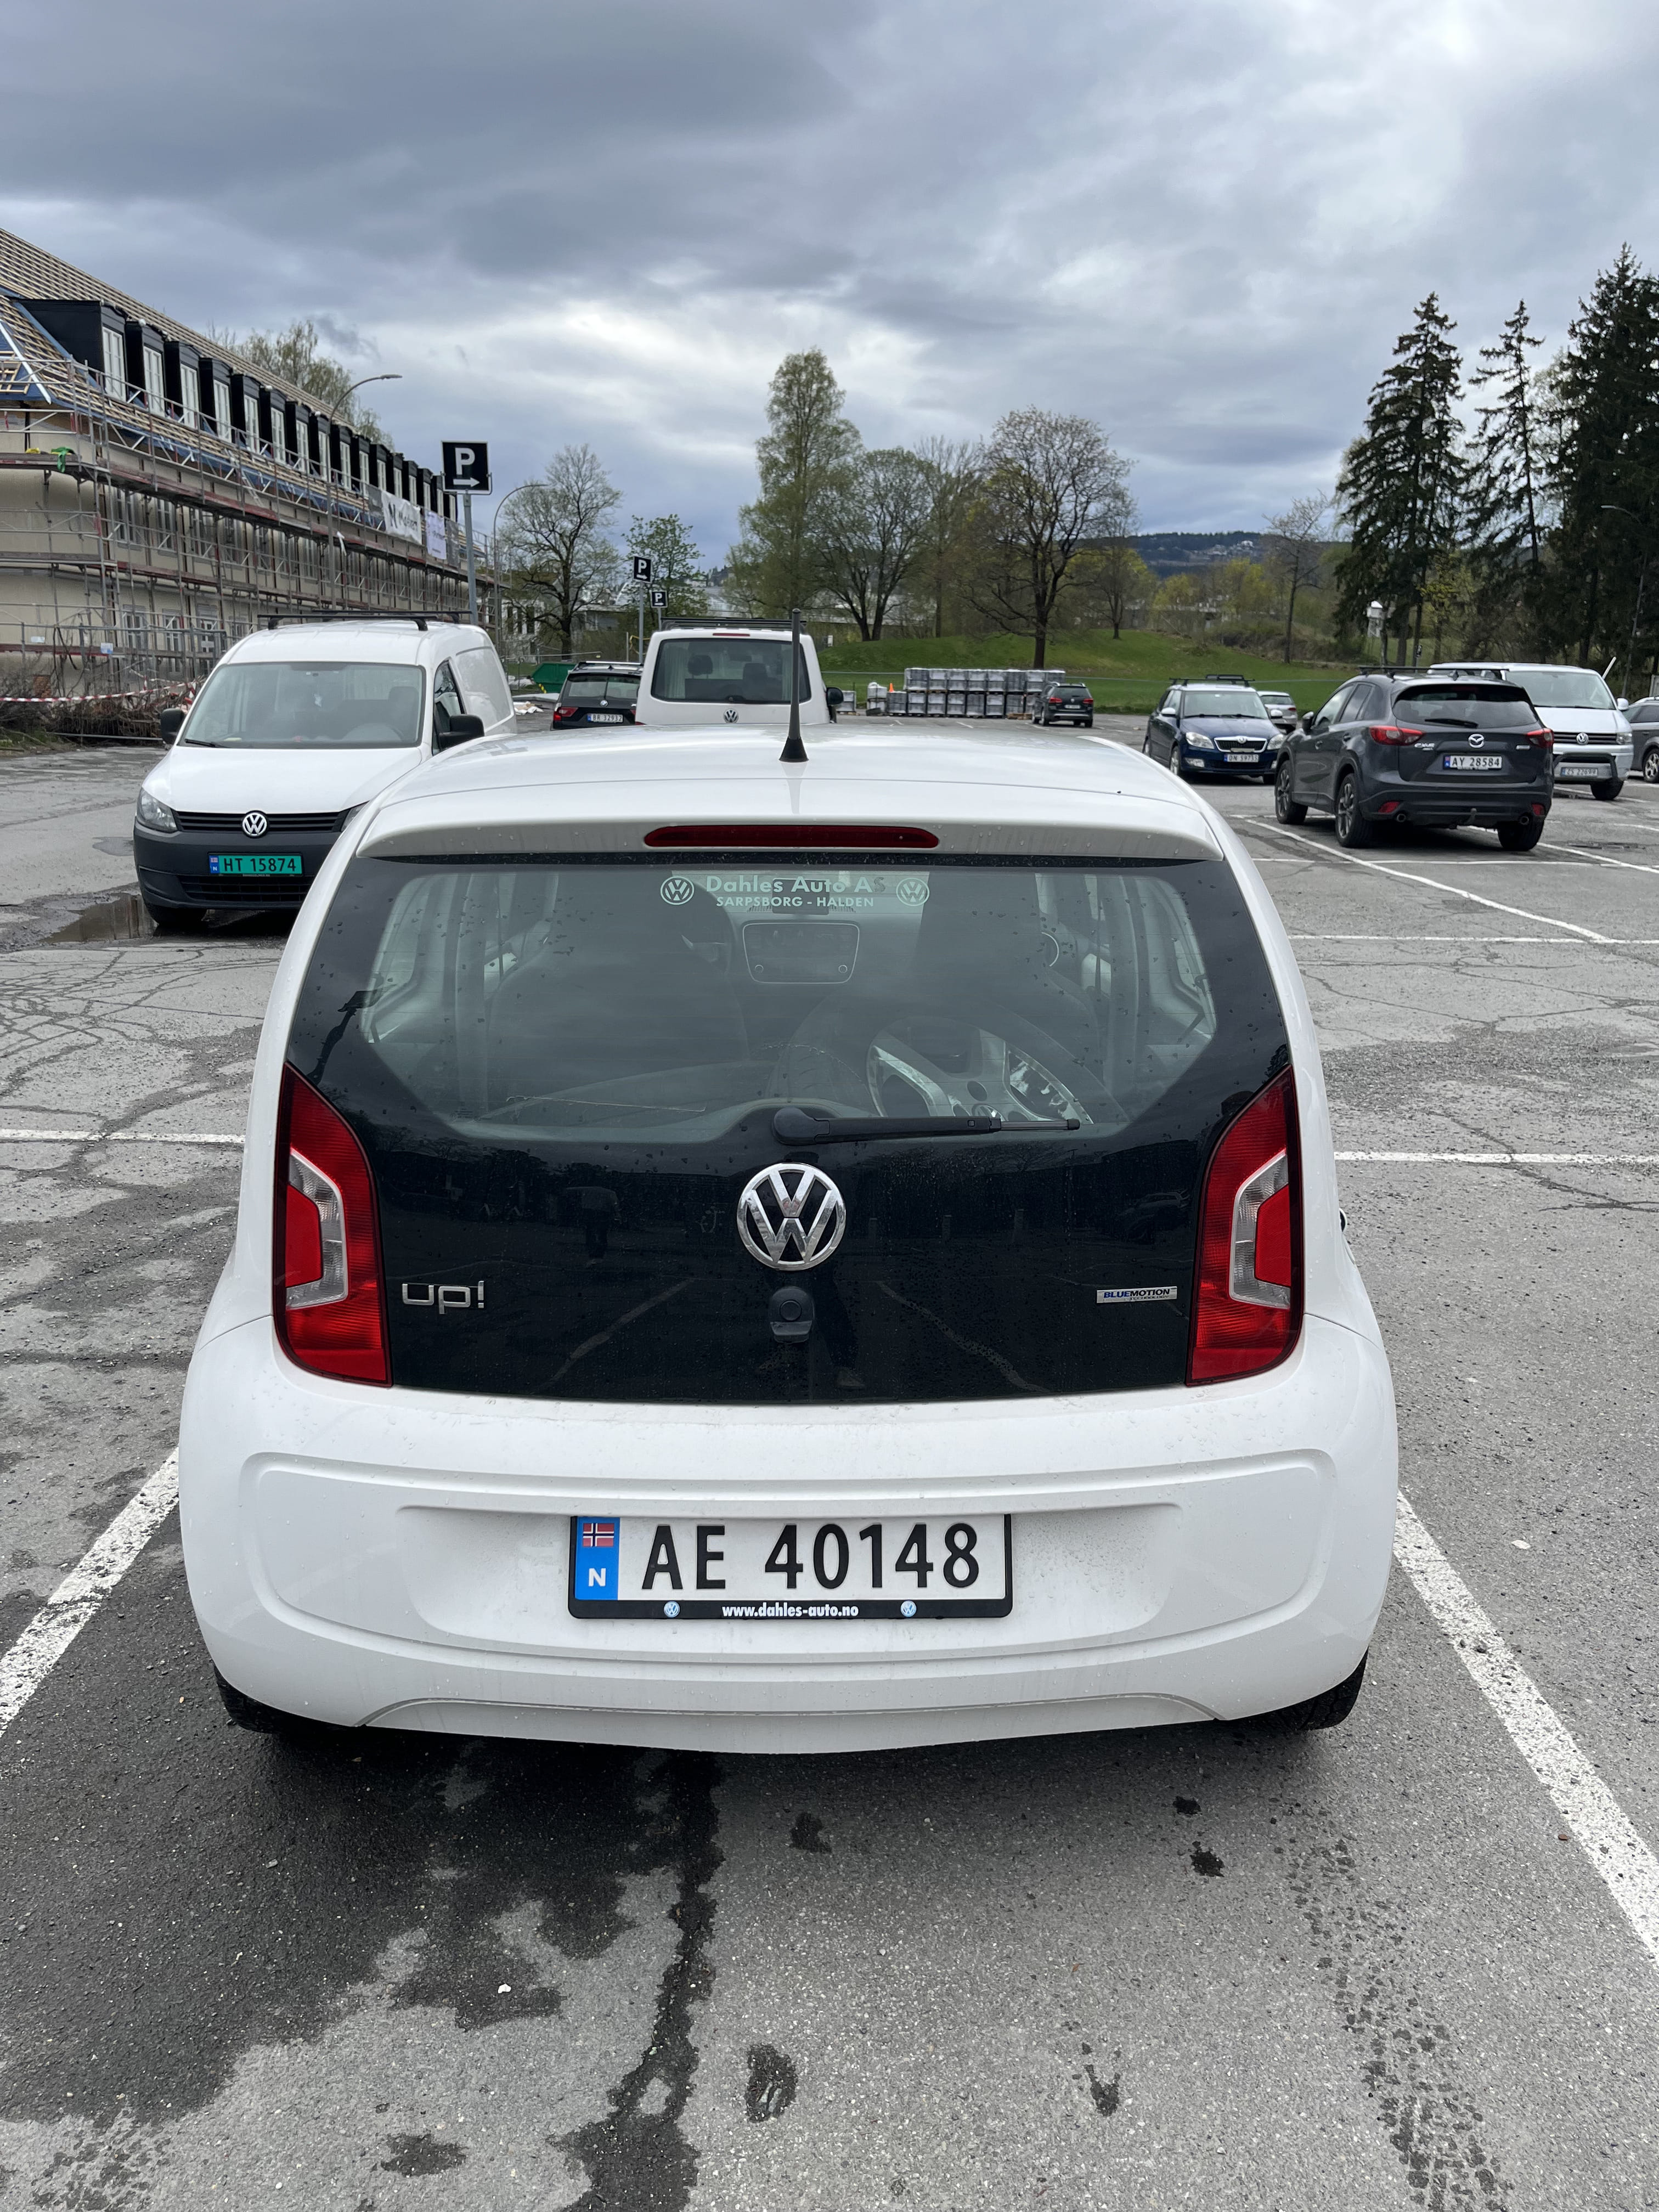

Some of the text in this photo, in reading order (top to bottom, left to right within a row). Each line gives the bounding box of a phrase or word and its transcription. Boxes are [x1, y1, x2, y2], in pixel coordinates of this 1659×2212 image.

[455, 448, 475, 475] P
[638, 560, 647, 573] P
[655, 592, 663, 602] P
[1452, 757, 1500, 766] AY 28584
[224, 858, 296, 872] HT 15874
[707, 875, 885, 893] Dahles Auto AS
[716, 896, 803, 907] SARPSBORG
[817, 897, 873, 907] HALDEN
[737, 1162, 846, 1271] VW
[402, 1280, 484, 1314] up!
[1104, 1289, 1170, 1299] BLUEMOTION
[642, 1523, 979, 1589] AE 40148
[588, 1568, 606, 1587] N
[722, 1602, 859, 1617] www.dahles-auto.no
